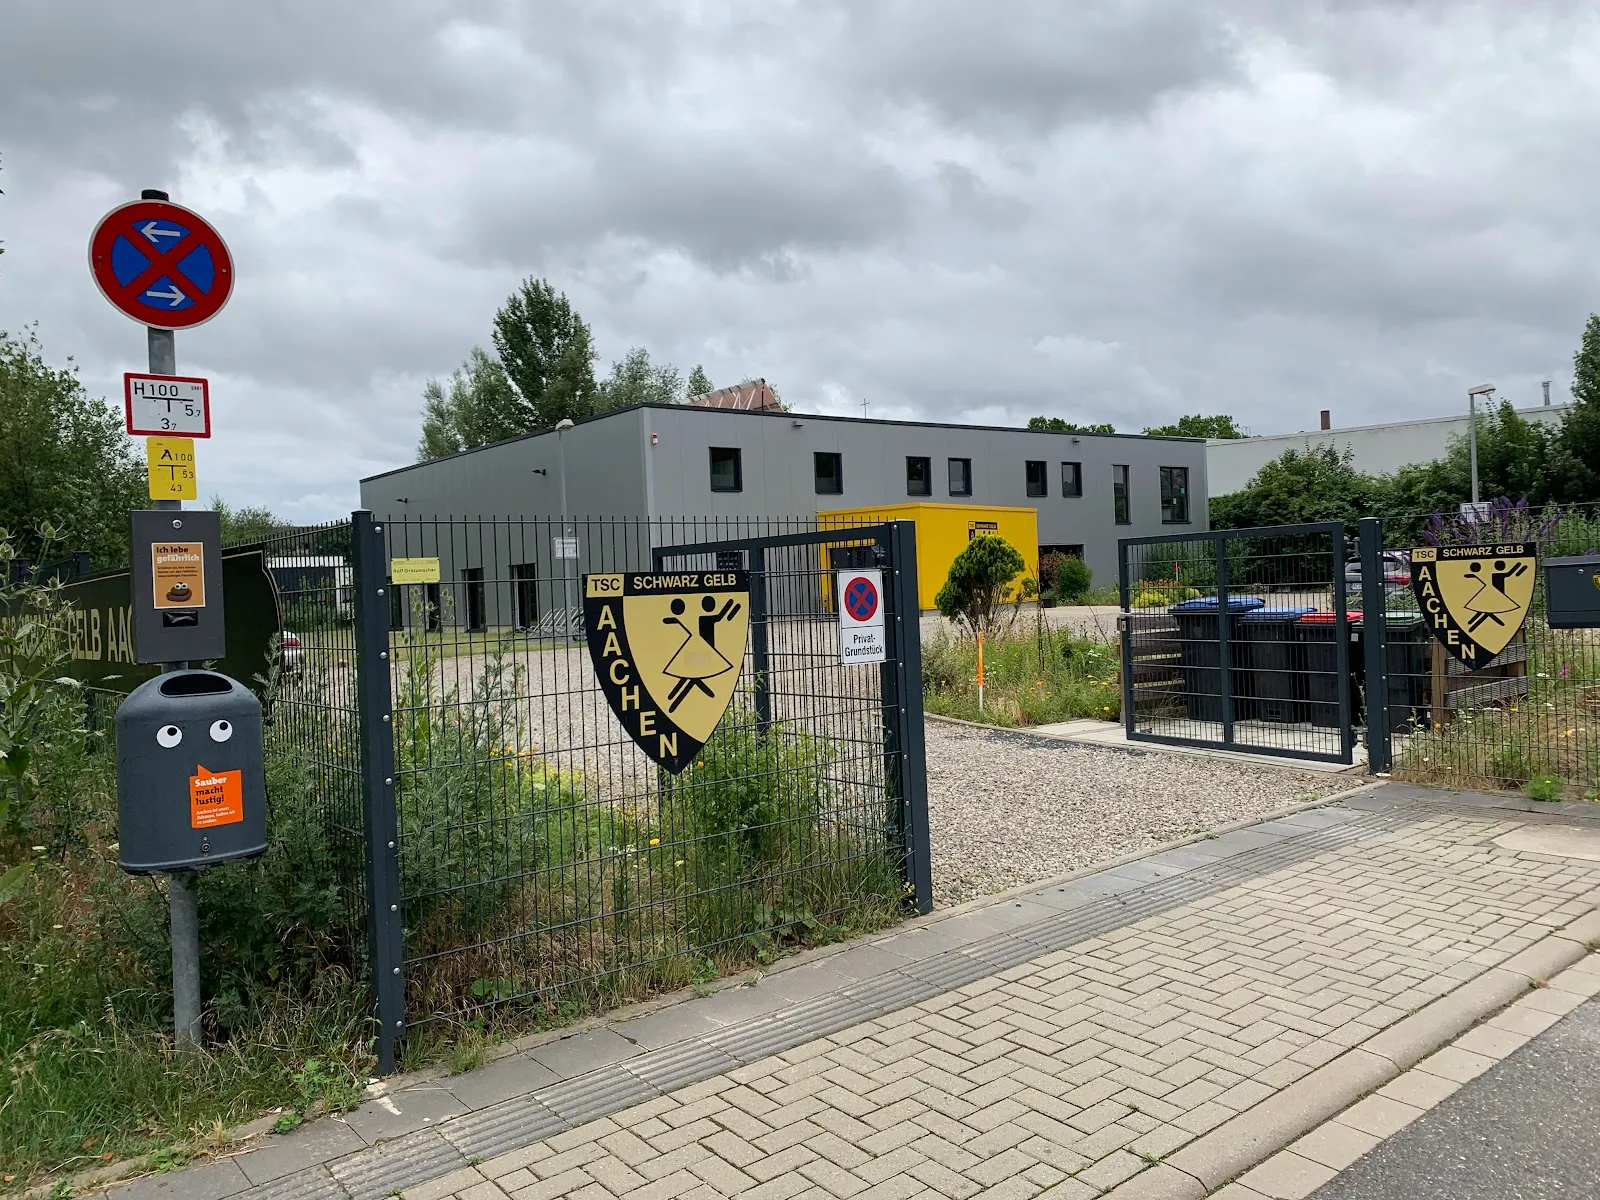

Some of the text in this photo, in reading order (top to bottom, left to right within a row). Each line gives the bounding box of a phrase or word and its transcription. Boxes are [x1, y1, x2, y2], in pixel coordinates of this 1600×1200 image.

[1415, 545, 1524, 559] TSC SCHWARZ GELB
[156, 554, 200, 564] gefährlich
[591, 573, 737, 592] TSC SCHWARZ GELB
[853, 633, 876, 644] Privat-
[844, 645, 883, 657] Grundstück
[195, 777, 227, 787] Sauber
[196, 786, 223, 796] macht
[195, 794, 224, 805] lustig!
